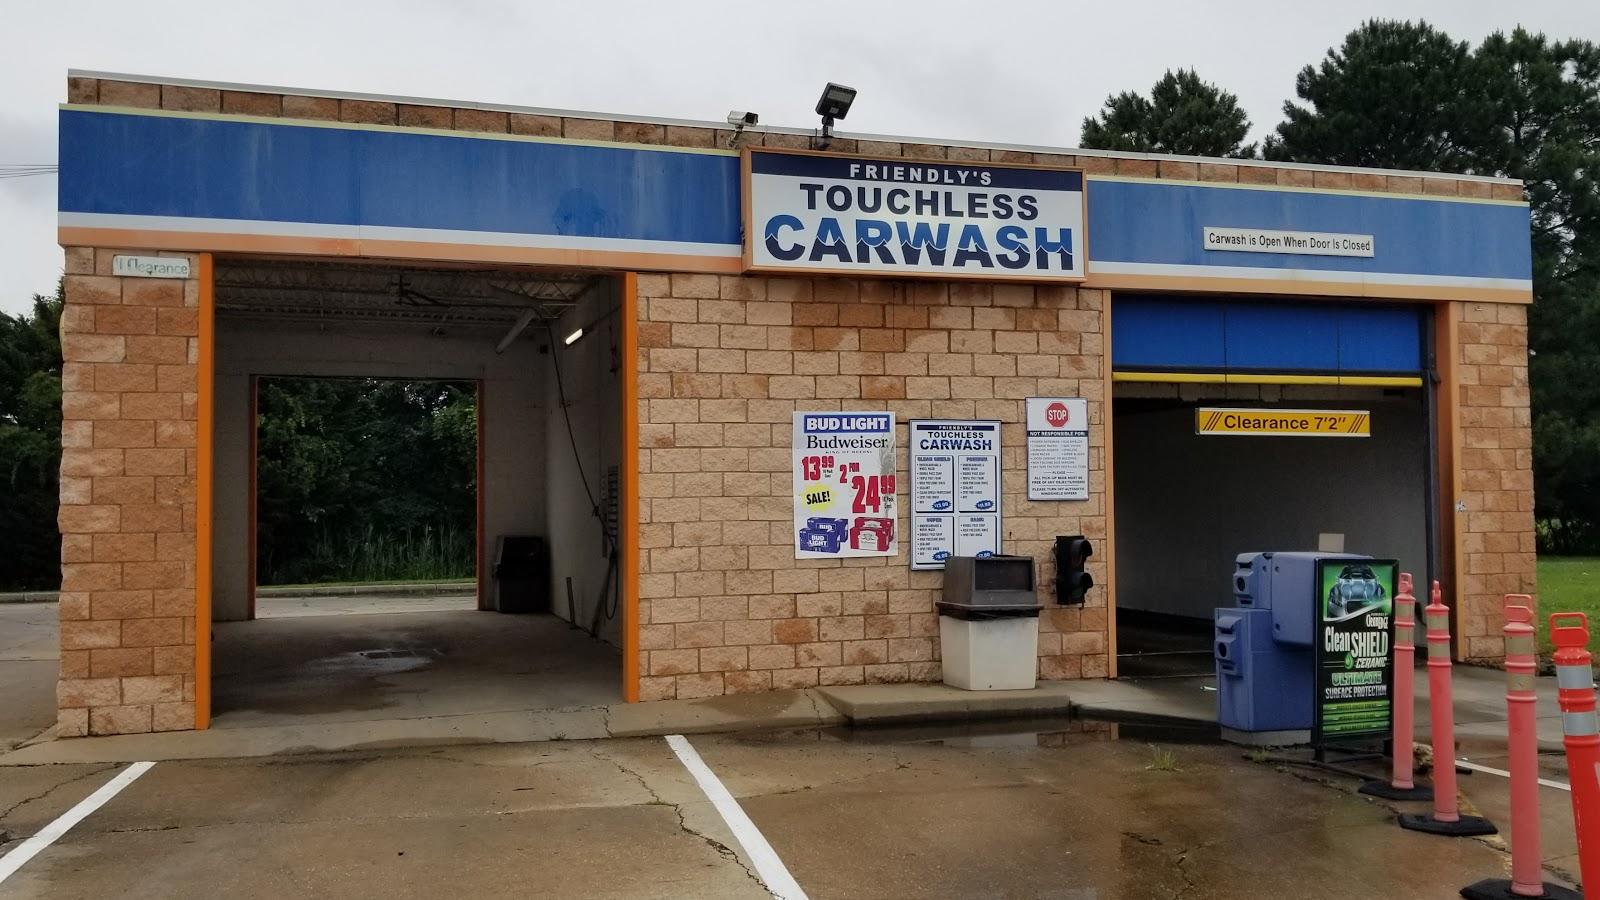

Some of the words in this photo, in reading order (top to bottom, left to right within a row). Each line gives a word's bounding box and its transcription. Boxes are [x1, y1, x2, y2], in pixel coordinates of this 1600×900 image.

[850, 163, 993, 186] FRIENDLY'S
[800, 183, 1039, 221] TOUCHLESS
[764, 214, 1074, 271] CARWASH
[1209, 232, 1247, 245] Carwash
[1250, 234, 1256, 246] is
[1259, 235, 1282, 248] Open
[1284, 236, 1308, 248] When
[1310, 238, 1331, 249] Door
[1342, 239, 1370, 251] Closed
[1048, 410, 1067, 420] STOP
[1224, 414, 1309, 430] Clearance
[806, 417, 840, 431] BUD
[842, 417, 888, 430] LIGHT
[807, 435, 888, 449] Budweiser
[920, 439, 992, 450] CARWASH
[840, 464, 848, 484] 2
[849, 462, 860, 472] FOR
[806, 490, 831, 505] SALE!
[1325, 626, 1351, 652] Clean
[1351, 632, 1388, 658] SHIELD
[1356, 657, 1387, 669] CERAMIC
[1332, 671, 1382, 686] ULTIMATE
[1325, 686, 1353, 699] SURFACE
[1353, 685, 1387, 698] PROTECTION
